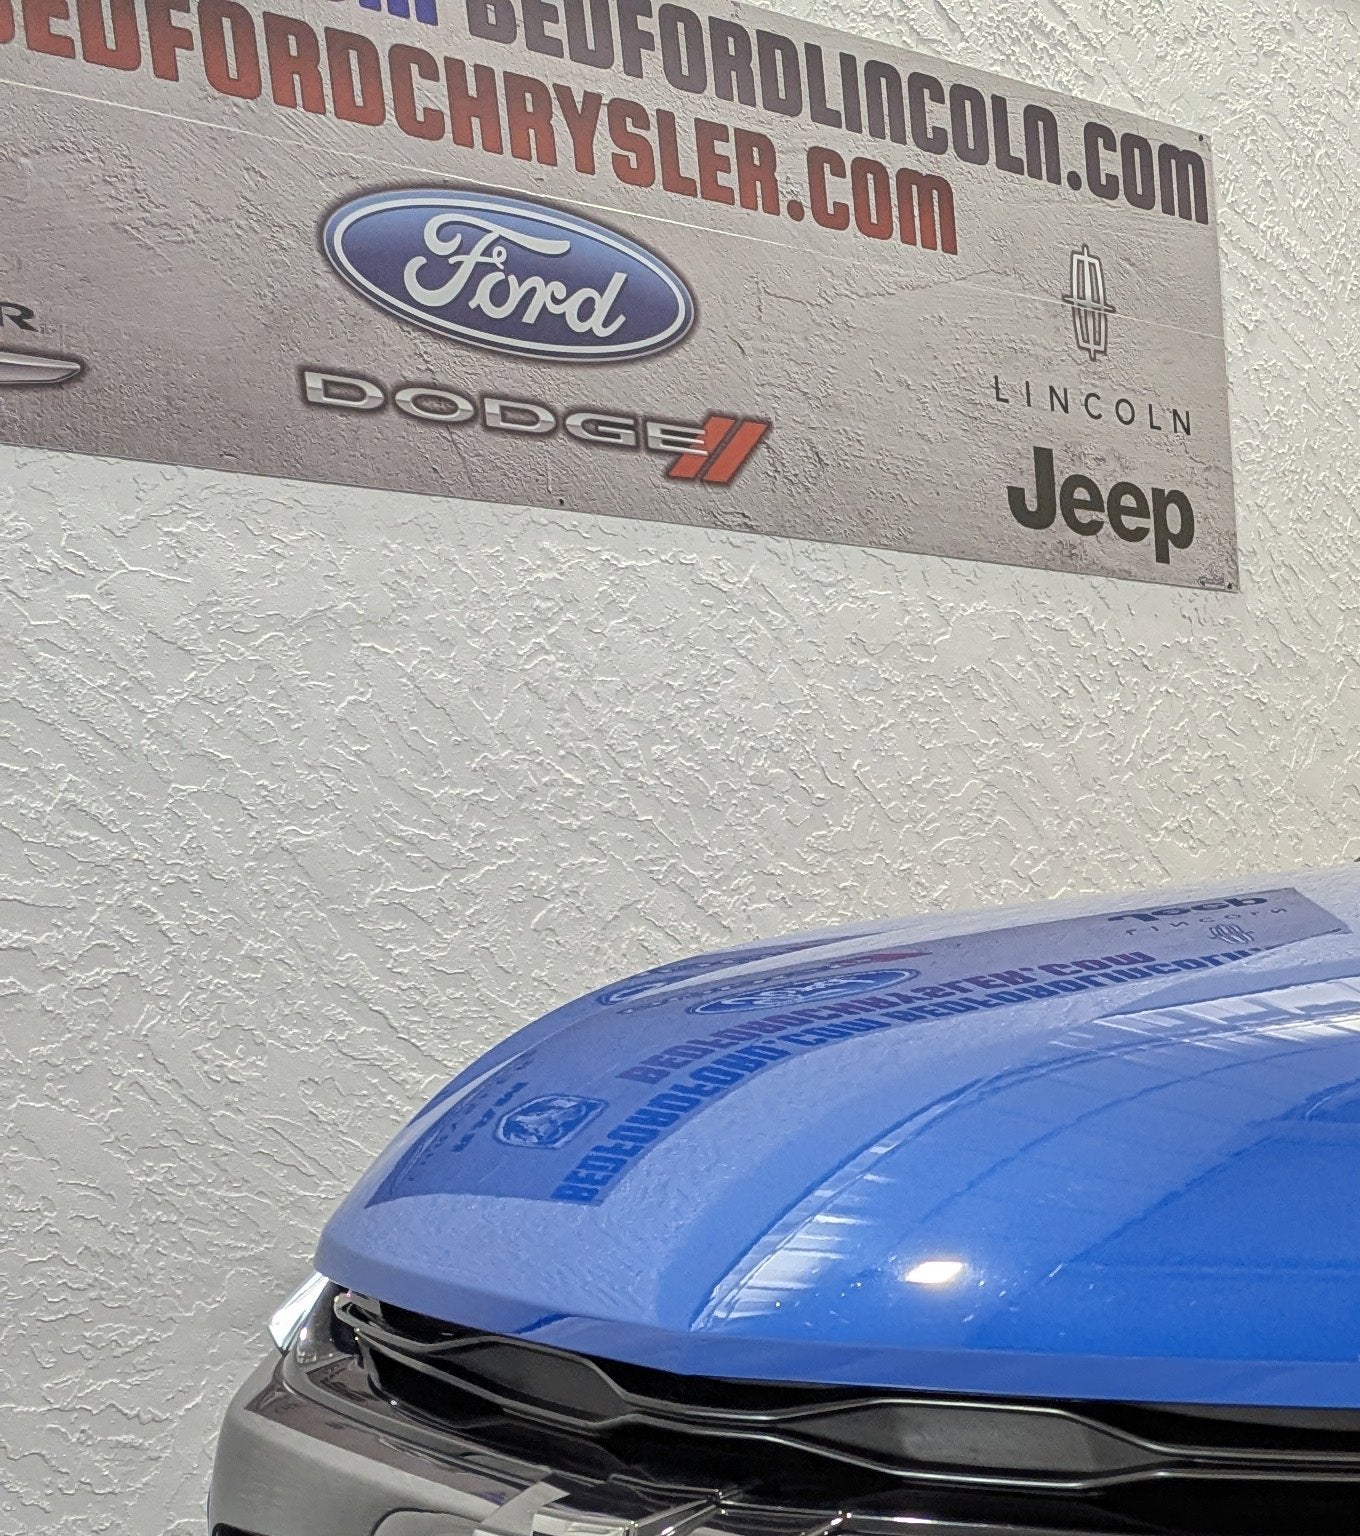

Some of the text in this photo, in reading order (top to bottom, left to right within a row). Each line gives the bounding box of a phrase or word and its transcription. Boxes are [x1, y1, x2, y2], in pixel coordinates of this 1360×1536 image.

[0, 0, 958, 255] EDFORDCHRYSLER.COM
[404, 213, 626, 338] Ford
[303, 370, 709, 456] DODGE
[994, 375, 1192, 437] LINCOLN
[1007, 447, 1195, 564] Jeep
